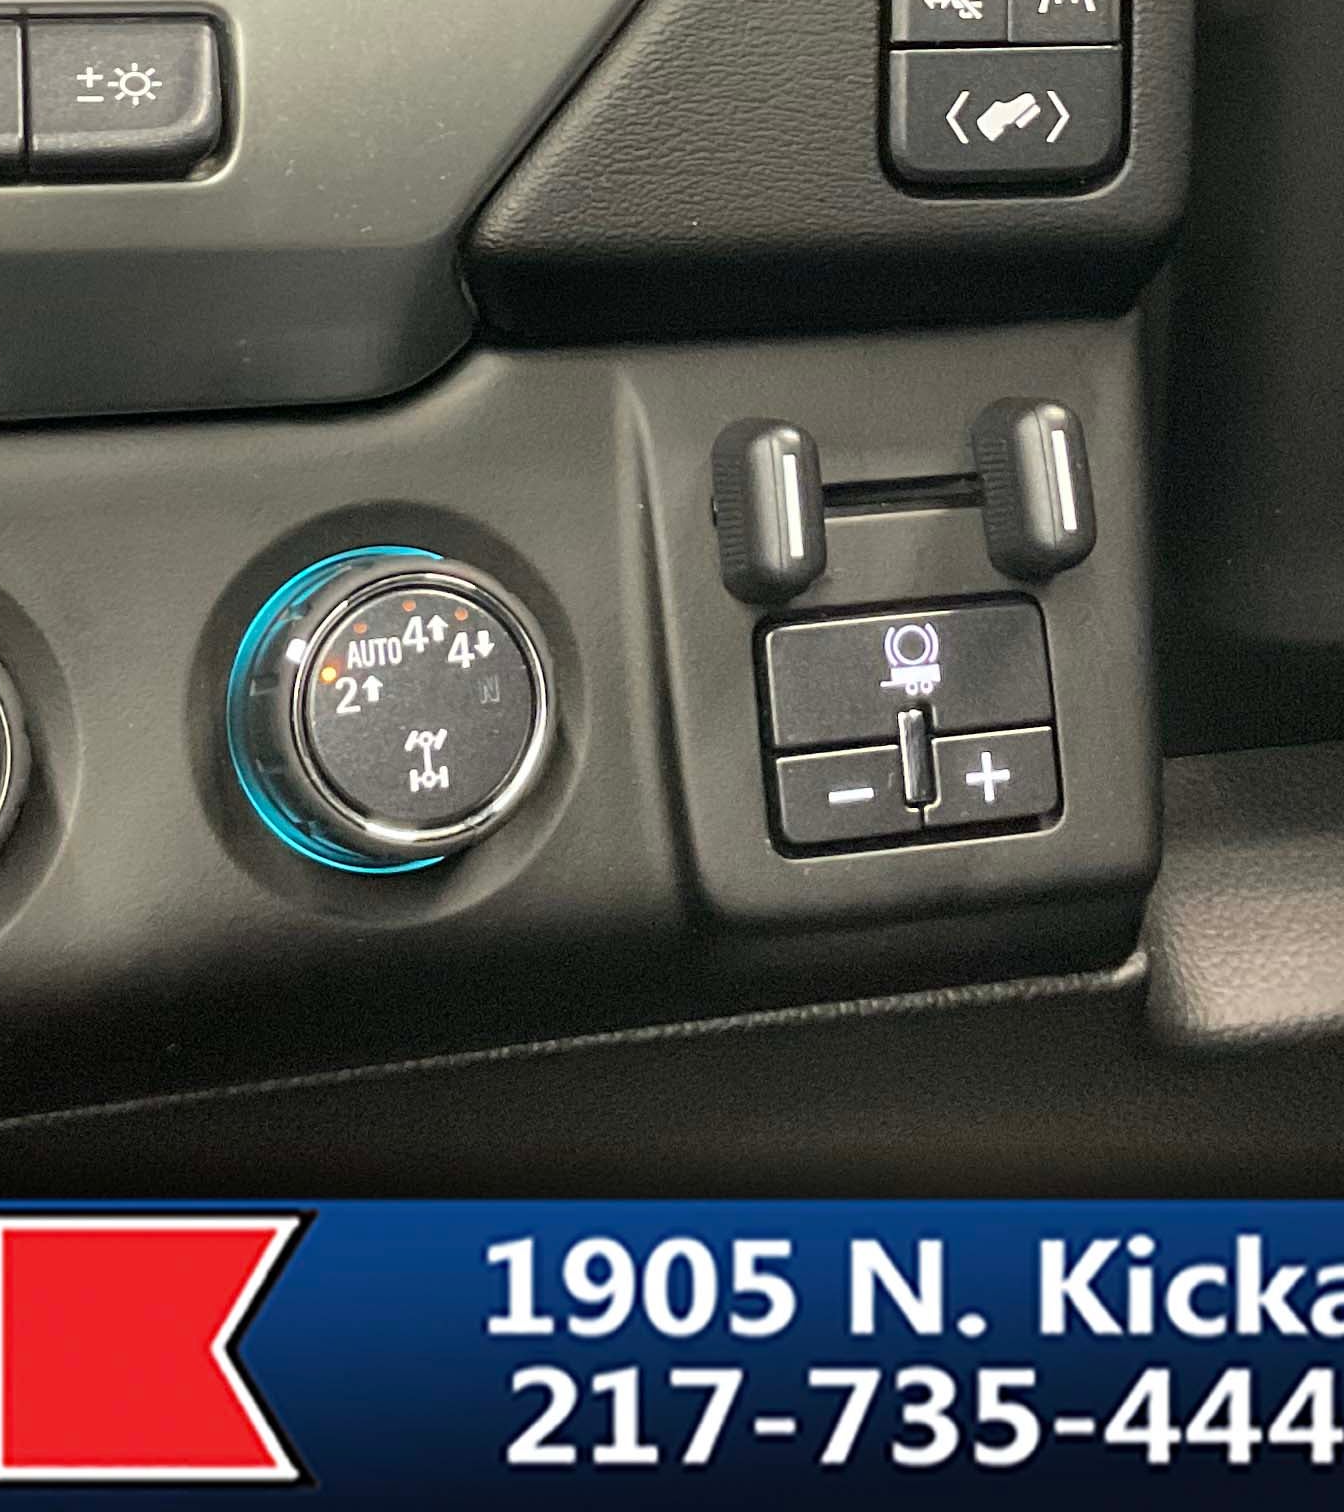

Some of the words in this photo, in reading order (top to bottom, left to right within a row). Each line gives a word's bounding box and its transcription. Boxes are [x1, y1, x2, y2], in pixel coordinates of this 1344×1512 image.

[402, 615, 429, 653] 4
[447, 631, 475, 669] 4
[347, 637, 403, 670] AUTO
[335, 676, 361, 714] 2
